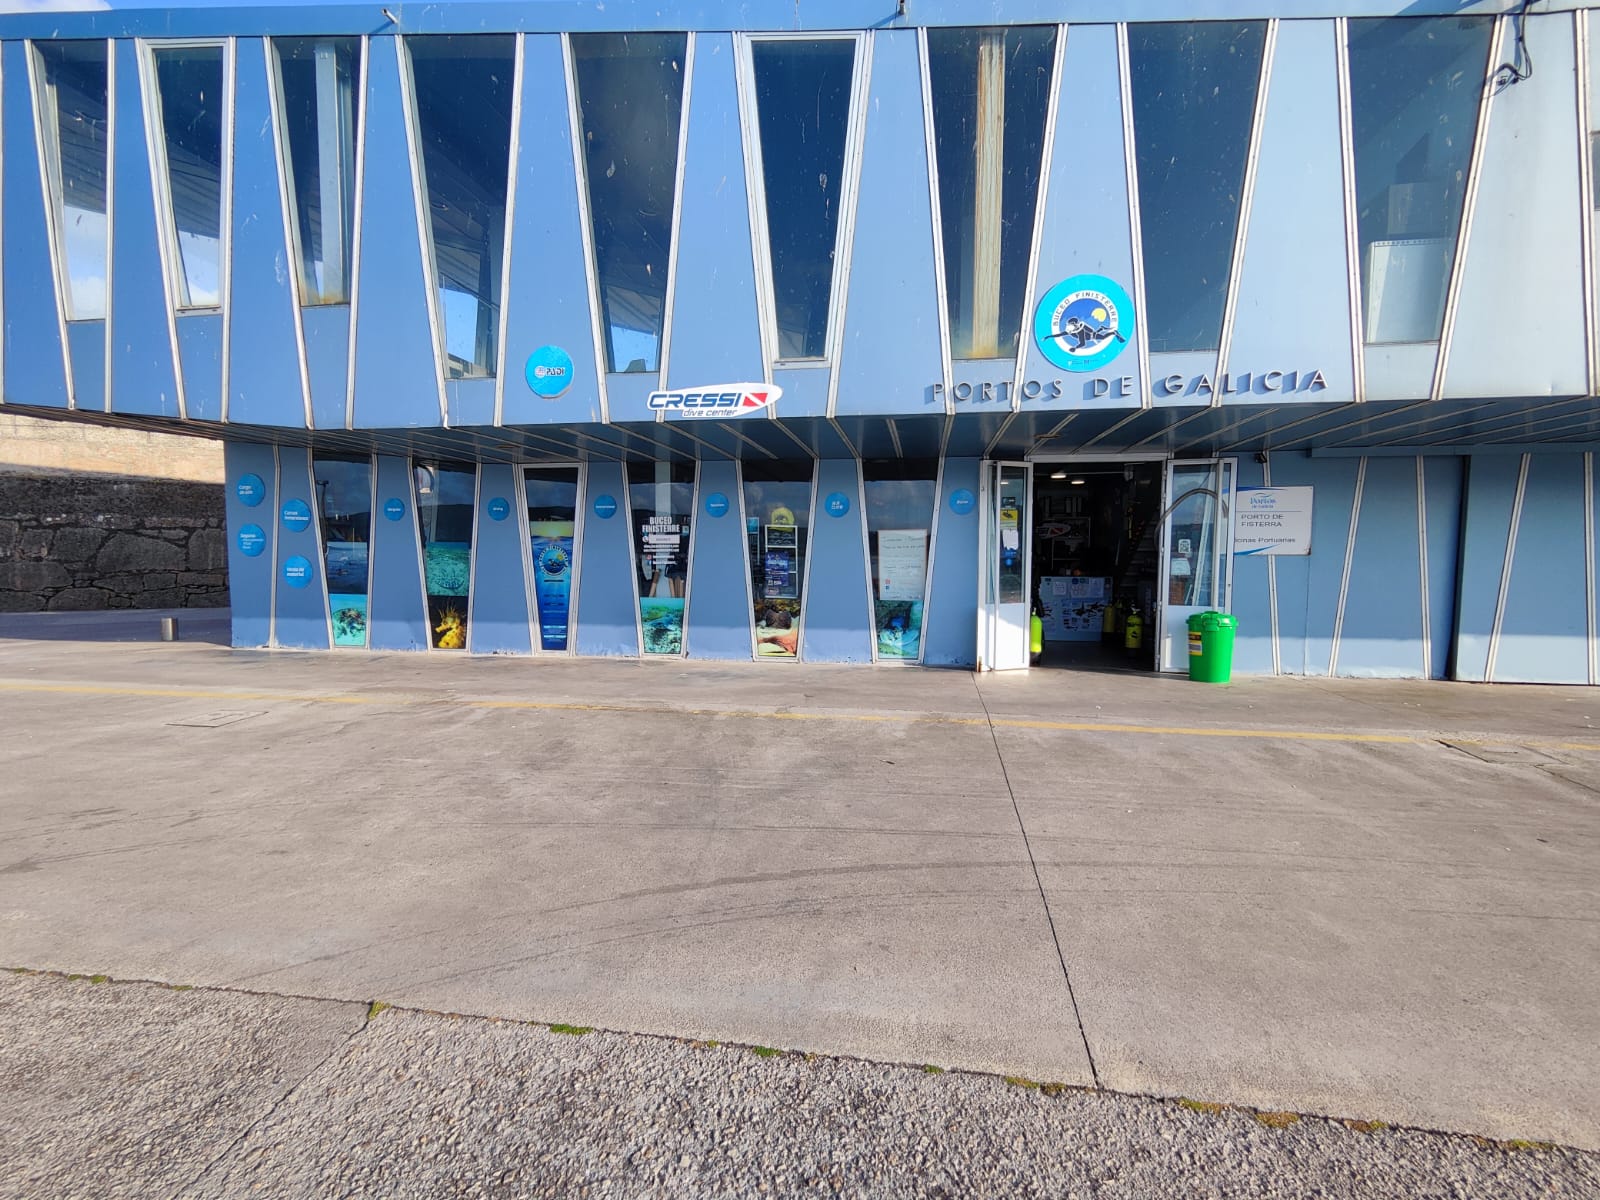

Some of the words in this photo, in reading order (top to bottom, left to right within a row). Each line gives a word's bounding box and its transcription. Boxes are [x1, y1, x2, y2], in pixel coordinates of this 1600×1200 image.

[1052, 298, 1071, 327] BUCEO
[1075, 291, 1118, 323] FINISTERRE
[546, 367, 565, 376] PADI
[932, 378, 1063, 401] PORTOS
[1094, 375, 1134, 397] DE
[1164, 368, 1330, 395] GALICIA
[649, 392, 742, 409] CRESSI
[683, 409, 704, 417] dive
[705, 409, 738, 417] center
[650, 516, 672, 525] BUCEO
[642, 524, 681, 533] FINISTERRE
